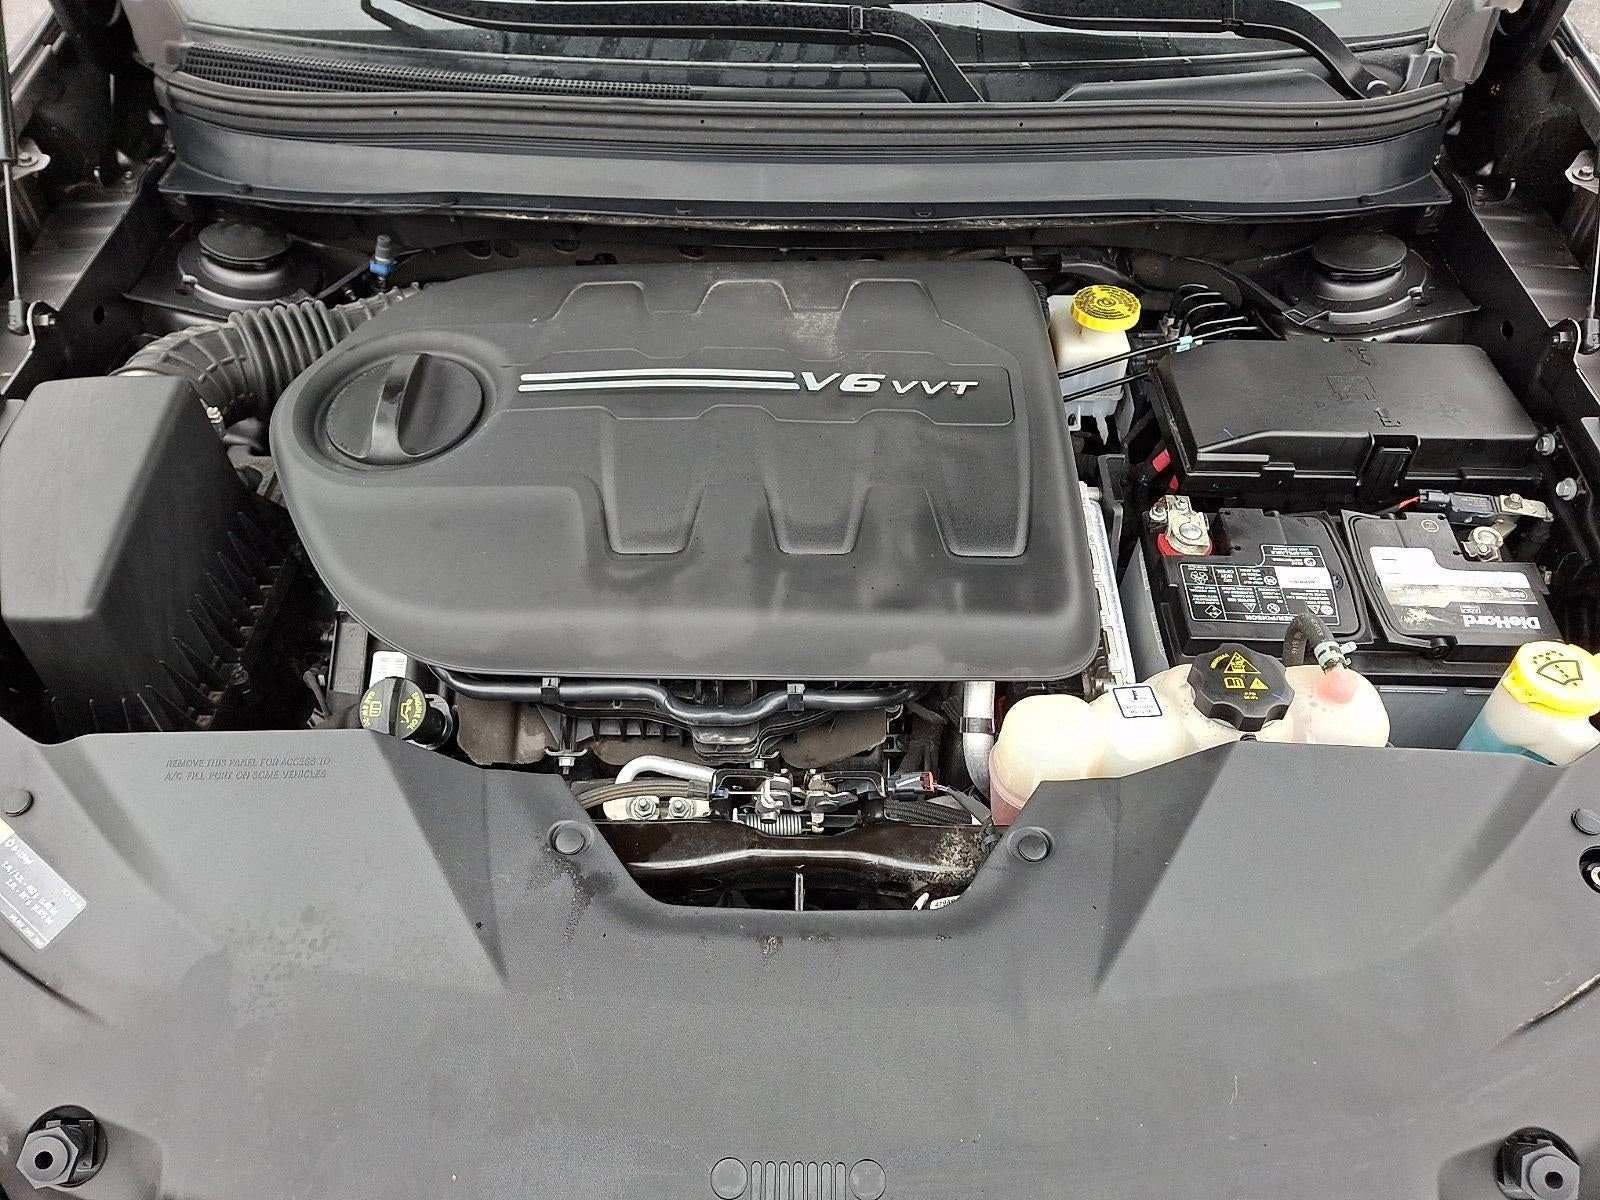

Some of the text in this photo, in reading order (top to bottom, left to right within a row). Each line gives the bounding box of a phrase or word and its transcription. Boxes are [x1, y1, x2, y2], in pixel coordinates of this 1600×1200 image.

[801, 371, 978, 396] V6 VVT
[1462, 614, 1541, 630] DieHard
[406, 691, 423, 730] ENGINE OIL
[165, 756, 332, 768] REMOVE THIS PANEL FOR ACCESS TO
[164, 769, 327, 781] A/C FILL PORT ON SOME VEHICLES
